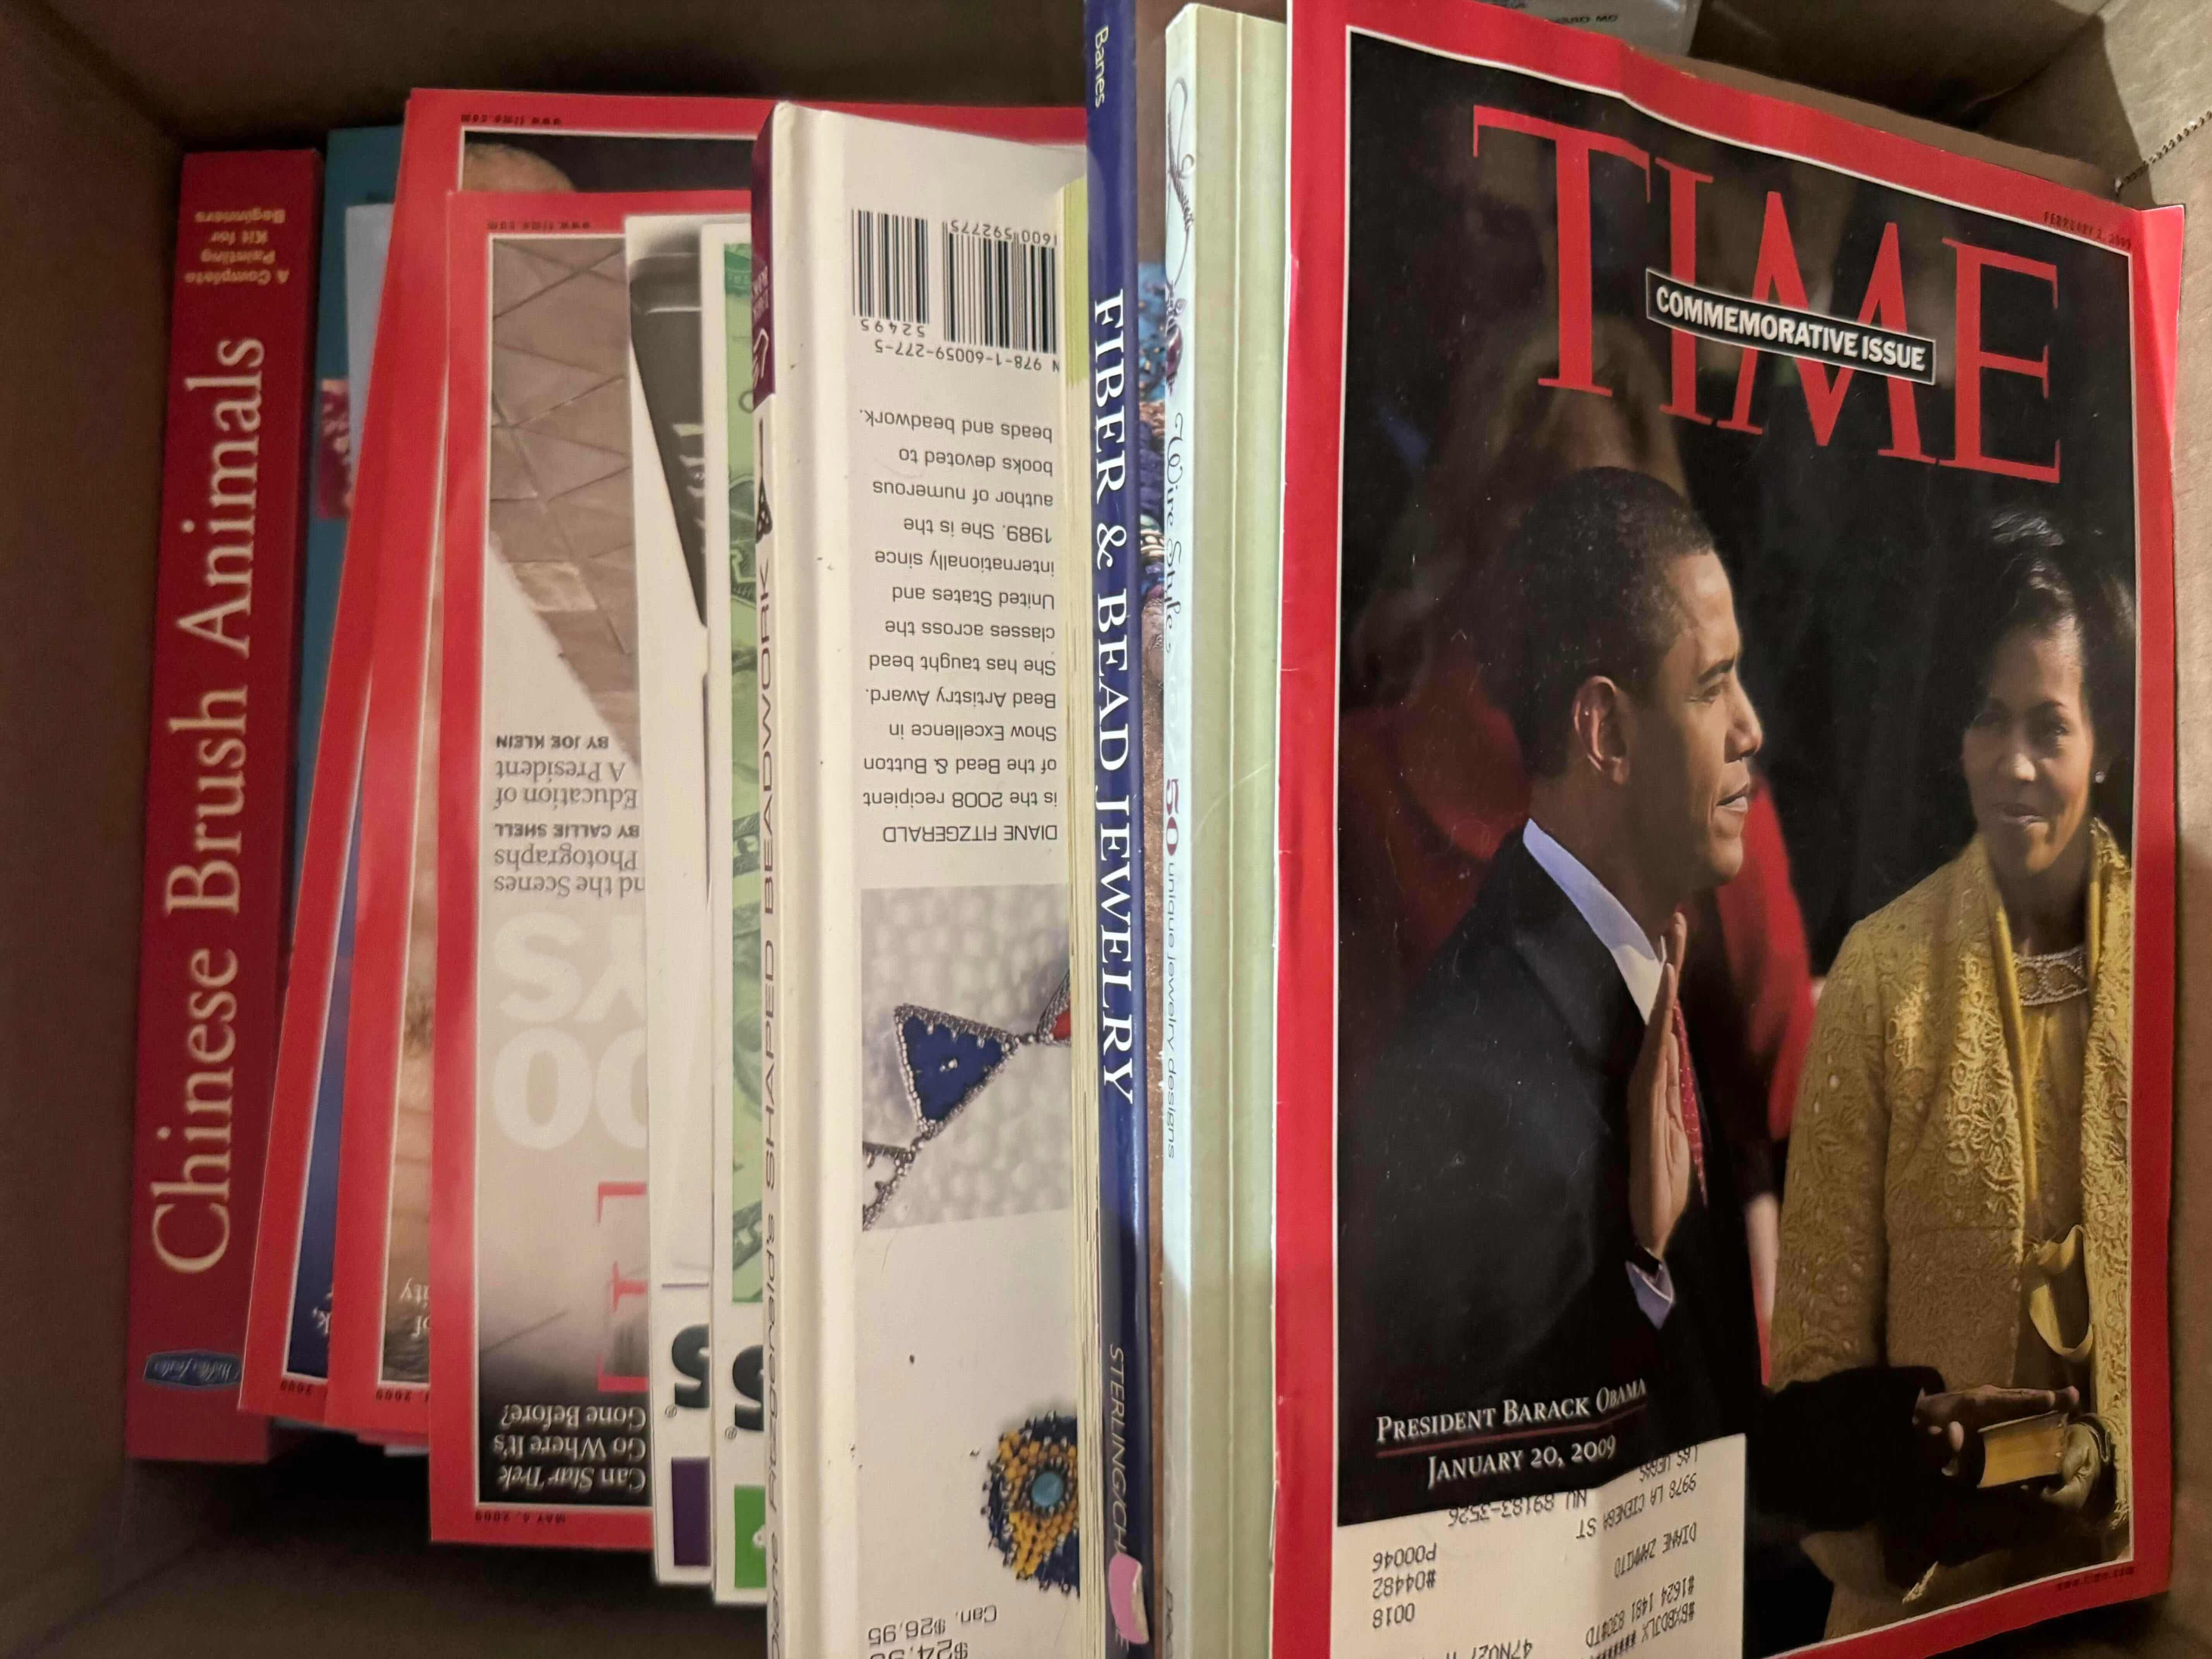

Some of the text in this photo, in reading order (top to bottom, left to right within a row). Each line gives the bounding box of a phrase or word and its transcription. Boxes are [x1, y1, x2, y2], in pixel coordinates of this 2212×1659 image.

[1094, 25, 1110, 109] Banes
[195, 207, 286, 224] Beginners
[2044, 211, 2094, 236] FEBRUARY
[242, 229, 268, 245] Kit
[950, 220, 1056, 246] 1600 592775
[200, 249, 276, 265] Painting
[184, 268, 290, 285] A Complete
[1473, 105, 2061, 483] TIME
[860, 319, 926, 337] 52495
[1656, 285, 1925, 371] COMMEMORATIVE ISSUE
[875, 340, 1042, 371] 978-1-60059-277-5
[860, 410, 1052, 443] beads and beadwork.
[899, 448, 1053, 477] books devoted to
[873, 481, 1053, 508] author of numerous
[904, 518, 1052, 543] 1989. She is the
[1164, 413, 1185, 653] Wire Style
[875, 550, 1054, 577] internationally since
[893, 587, 1054, 610] United States and
[885, 621, 1055, 642] classes across the
[869, 653, 1056, 676] She has taught bead
[866, 687, 1056, 709] Bead Artistry Award.
[1094, 289, 1134, 1105] FIBER & BEAD JEWELRY
[496, 735, 609, 749] BY JOE KLEIN
[758, 557, 774, 915] BEADWORK
[890, 724, 1056, 742] Show Excellence in
[496, 760, 626, 784] A President
[864, 758, 1056, 774] of the Bead & Button
[151, 335, 265, 1273] Chinese Brush Animals
[493, 787, 637, 811] Education of
[863, 788, 1057, 808] is the 2008 recipient
[495, 823, 640, 838] BY CALLIE SHELL
[883, 825, 1057, 843] DIANE FITZGERALD
[495, 843, 637, 871] Photographs
[494, 875, 570, 898] Scenes
[576, 876, 612, 899] the
[492, 911, 646, 1024] YS
[1165, 778, 1180, 1159] 50 unique jewelry designs
[764, 940, 775, 1191] SHAPED
[766, 1213, 779, 1512] Fitzgerald's
[500, 1404, 646, 1431] Gone Before?
[1377, 1378, 1647, 1443] PRESIDENT BARACK OBAMA
[493, 1434, 646, 1462] Go Where It's
[1427, 1435, 1617, 1490] JANUARY 20, 2009
[498, 1465, 646, 1494] Can Star Trek
[1650, 1485, 1663, 1506] LA
[538, 1513, 566, 1523] MAY
[1448, 1494, 1555, 1527] 89183-3526
[1576, 1518, 1596, 1540] ST
[1662, 1522, 1697, 1554] DIANE
[1372, 1542, 1437, 1572] P00046
[1372, 1570, 1436, 1599] #04482
[1661, 1576, 1695, 1607] #1624
[1372, 1603, 1415, 1629] 0018
[1632, 1592, 1654, 1622] 1481
[868, 1605, 997, 1645] Can. $26.95
